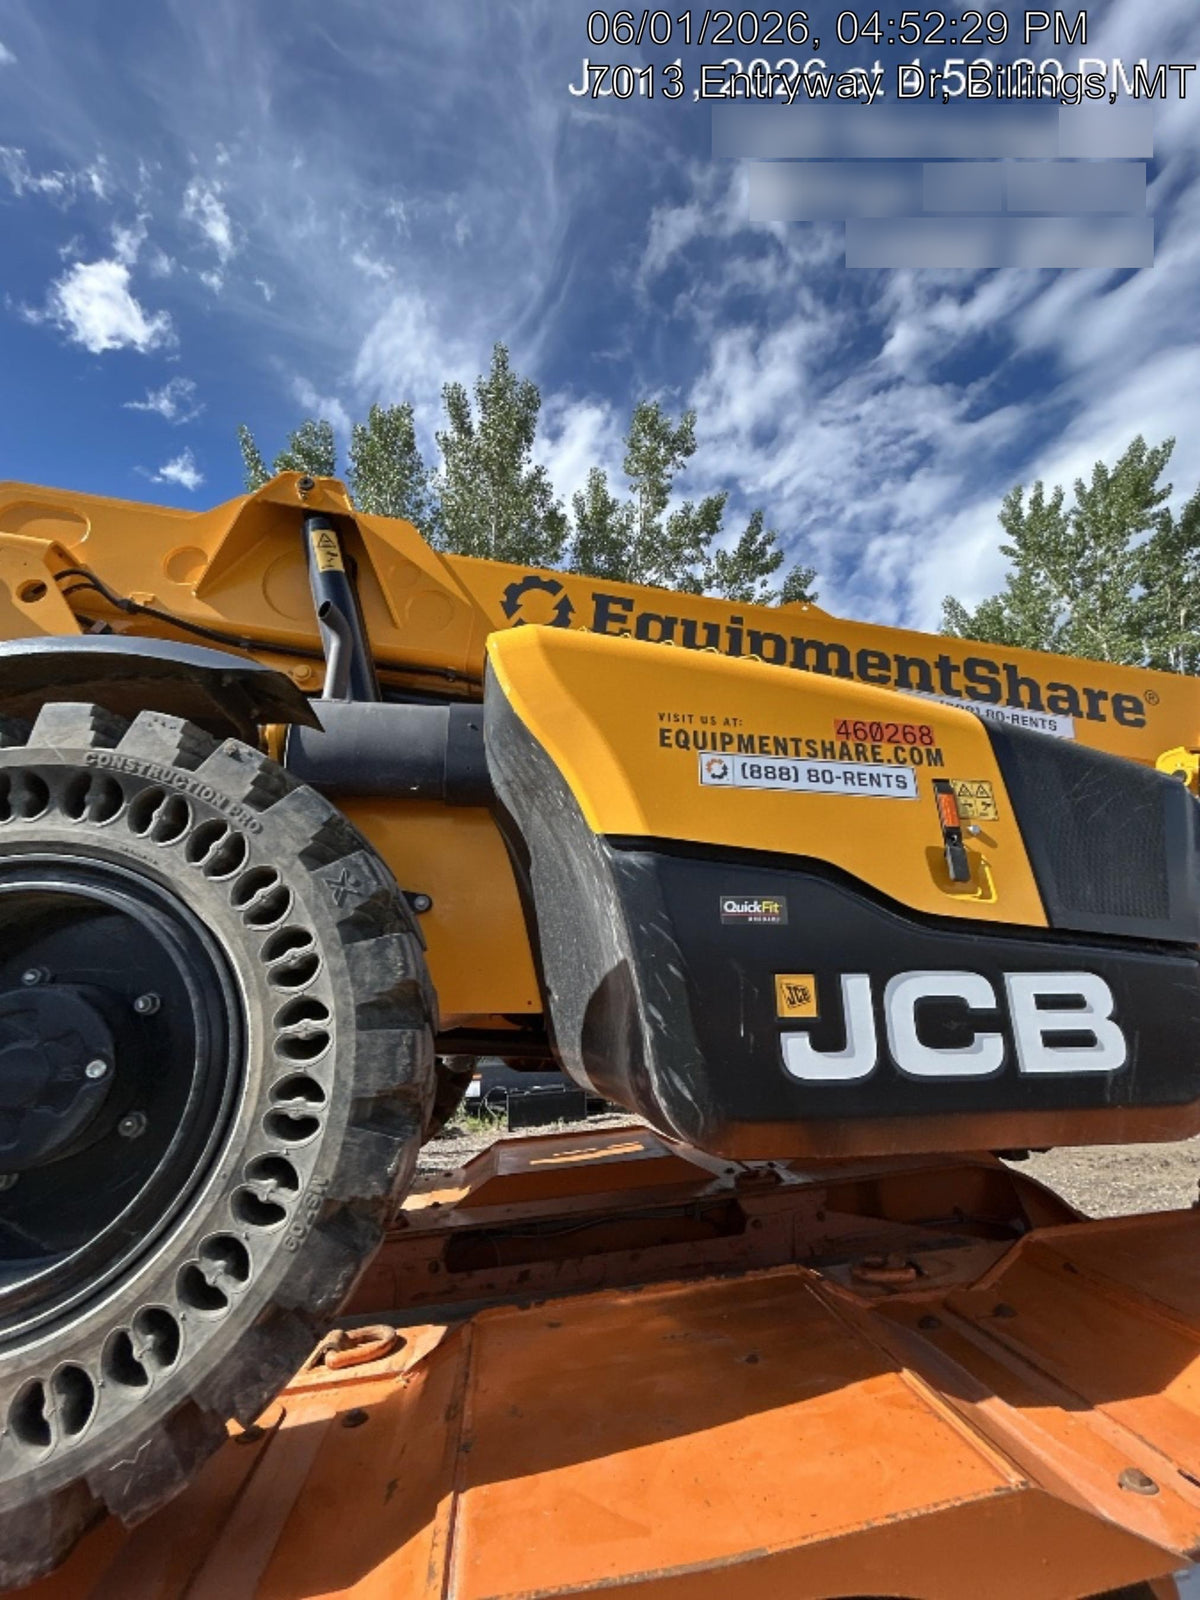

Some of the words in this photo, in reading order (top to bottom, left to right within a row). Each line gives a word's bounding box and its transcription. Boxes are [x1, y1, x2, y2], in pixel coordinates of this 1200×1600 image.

[658, 711, 694, 724] VISIT
[700, 715, 718, 726] US
[723, 717, 743, 728] AT:
[836, 719, 934, 747] 460268
[659, 727, 945, 768] EQUIPMENTSHARE.COM
[741, 762, 799, 783] (888)
[806, 768, 908, 790] 80-RENTS
[83, 751, 227, 811] CONSTRUCTION
[228, 800, 264, 835] PRO
[723, 900, 781, 914] QuickFit
[780, 970, 1128, 1080] JCB
